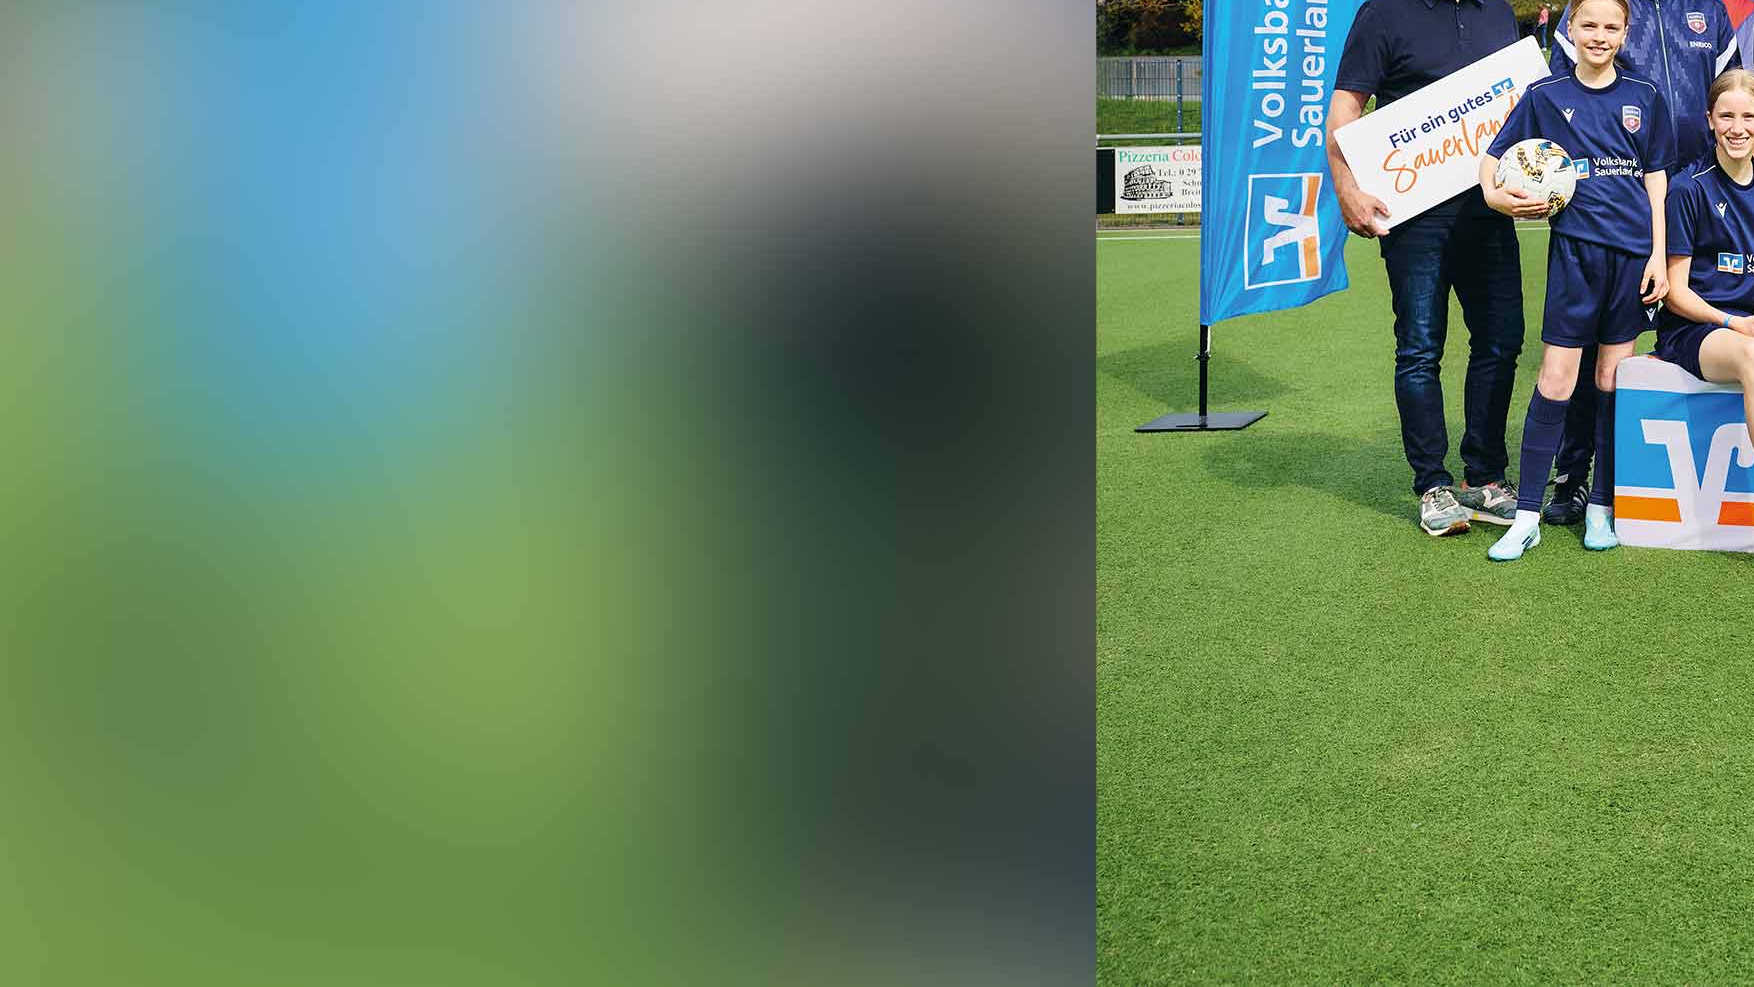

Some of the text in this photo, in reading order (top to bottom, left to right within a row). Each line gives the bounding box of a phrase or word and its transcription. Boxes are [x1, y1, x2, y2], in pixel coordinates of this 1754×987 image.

[1389, 90, 1493, 149] Für ein gutes
[1119, 150, 1169, 163] Pizzeria
[1594, 165, 1633, 177] Sauerlad
